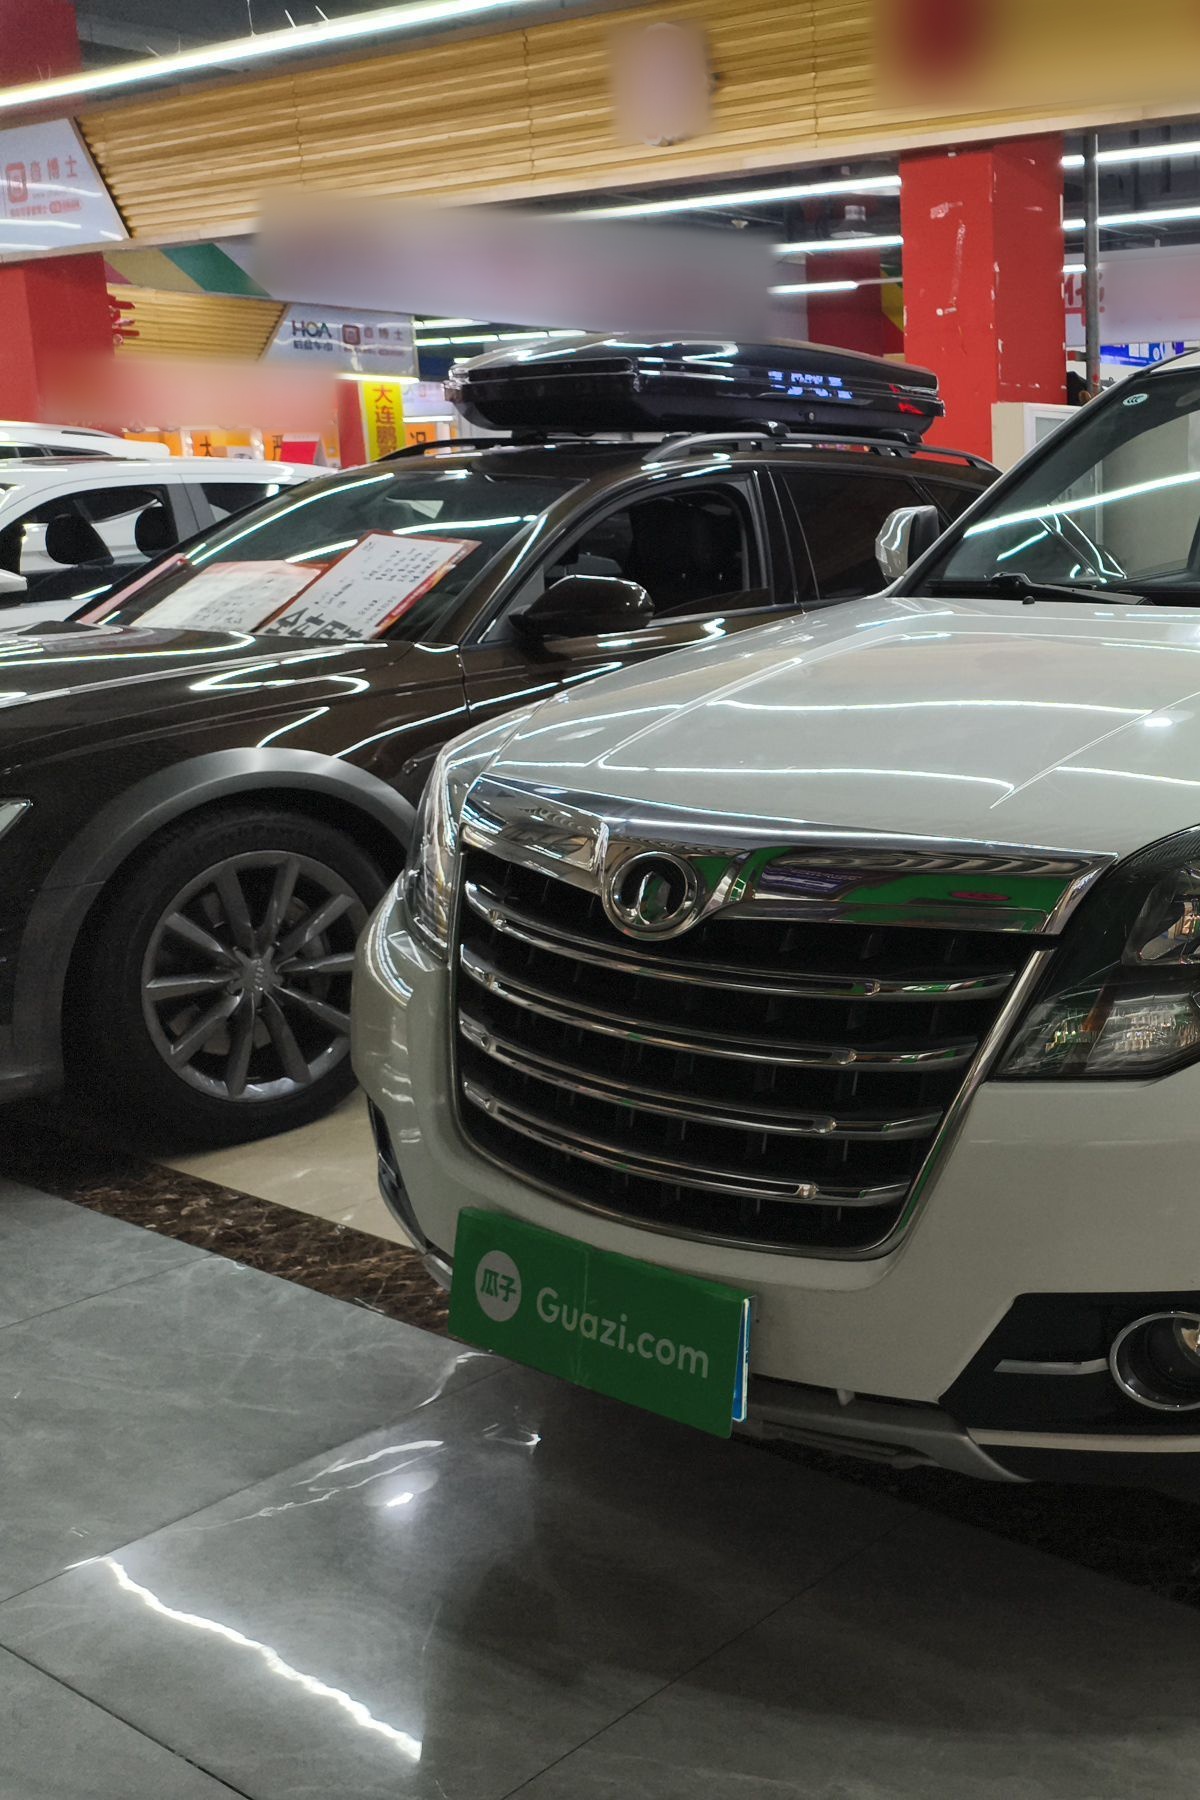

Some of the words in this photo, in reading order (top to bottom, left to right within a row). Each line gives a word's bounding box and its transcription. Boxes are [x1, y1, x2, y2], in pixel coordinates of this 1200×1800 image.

[291, 320, 333, 339] HOA
[481, 1268, 517, 1302] 瓜子
[536, 1286, 709, 1379] Guazi.com
